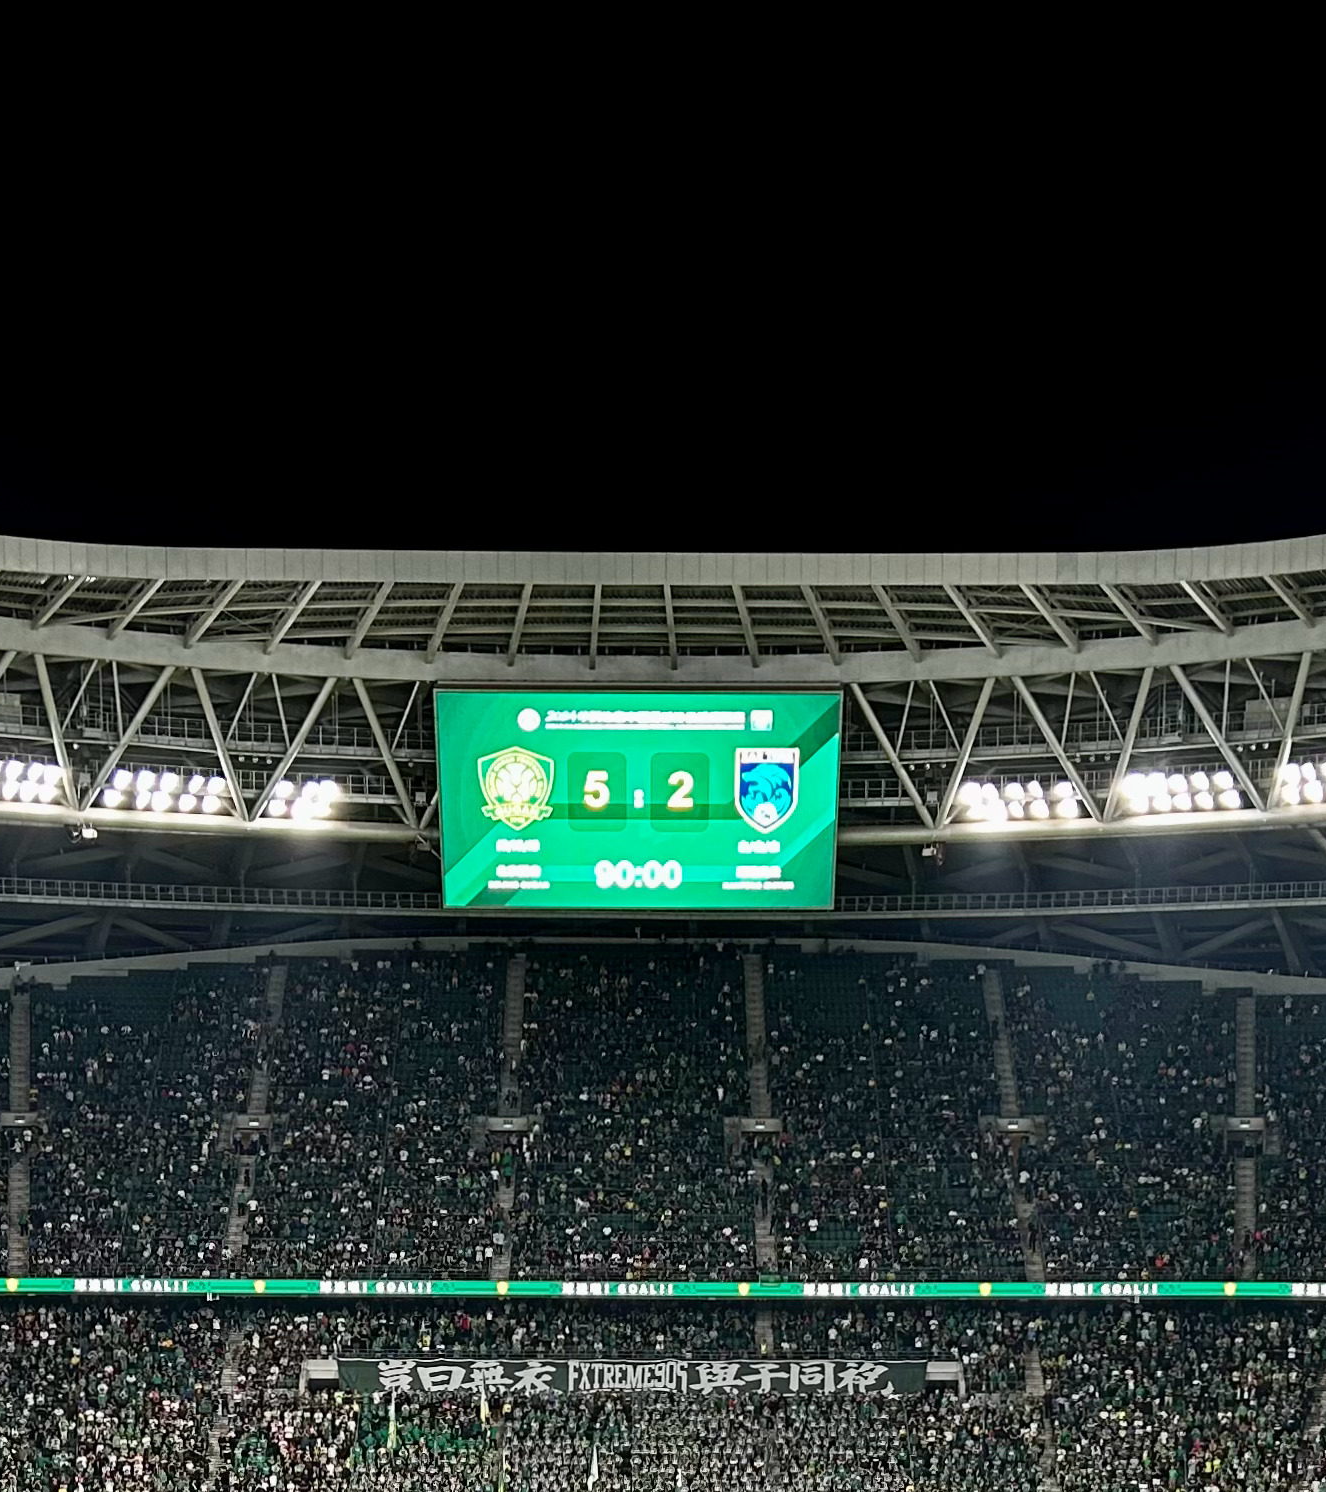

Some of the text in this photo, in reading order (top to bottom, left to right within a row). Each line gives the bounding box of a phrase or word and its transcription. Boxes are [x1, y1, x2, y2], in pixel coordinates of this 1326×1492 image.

[584, 770, 610, 809] 5
[668, 770, 694, 808] 2
[594, 859, 683, 889] 90:00
